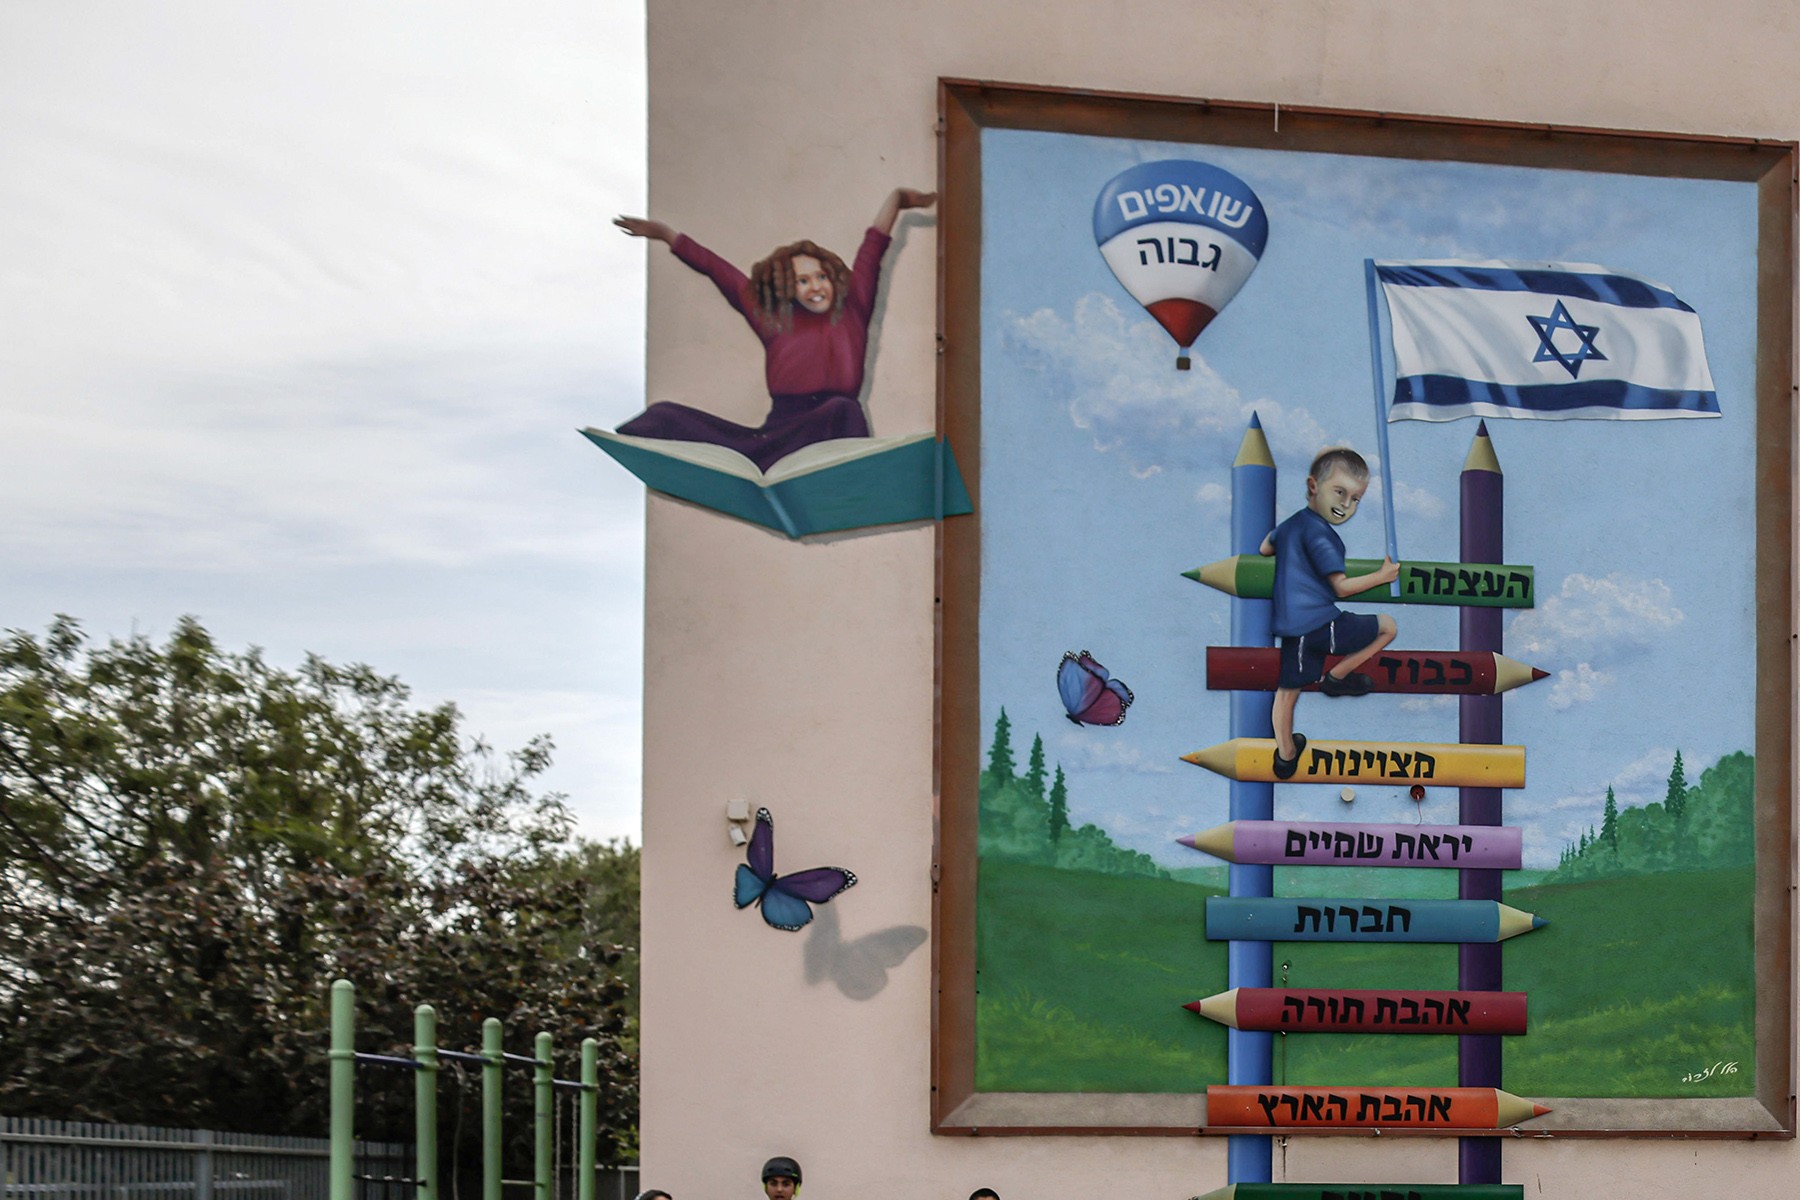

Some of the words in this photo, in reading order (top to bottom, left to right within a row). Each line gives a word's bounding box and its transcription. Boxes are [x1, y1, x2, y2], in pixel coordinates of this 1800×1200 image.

[1116, 183, 1253, 229] שואפים
[1137, 236, 1222, 272] גבוה
[1406, 567, 1531, 599] העצמה
[1378, 656, 1473, 686] כבוד
[1307, 747, 1436, 779] מצוינות
[1284, 829, 1384, 860] שמיים
[1391, 831, 1473, 861] יראת
[1293, 905, 1412, 934] חברות
[1281, 996, 1365, 1024] תורה
[1373, 998, 1471, 1025] אהבת
[1257, 1093, 1349, 1126] הארץ
[1356, 1093, 1452, 1122] אהבת
